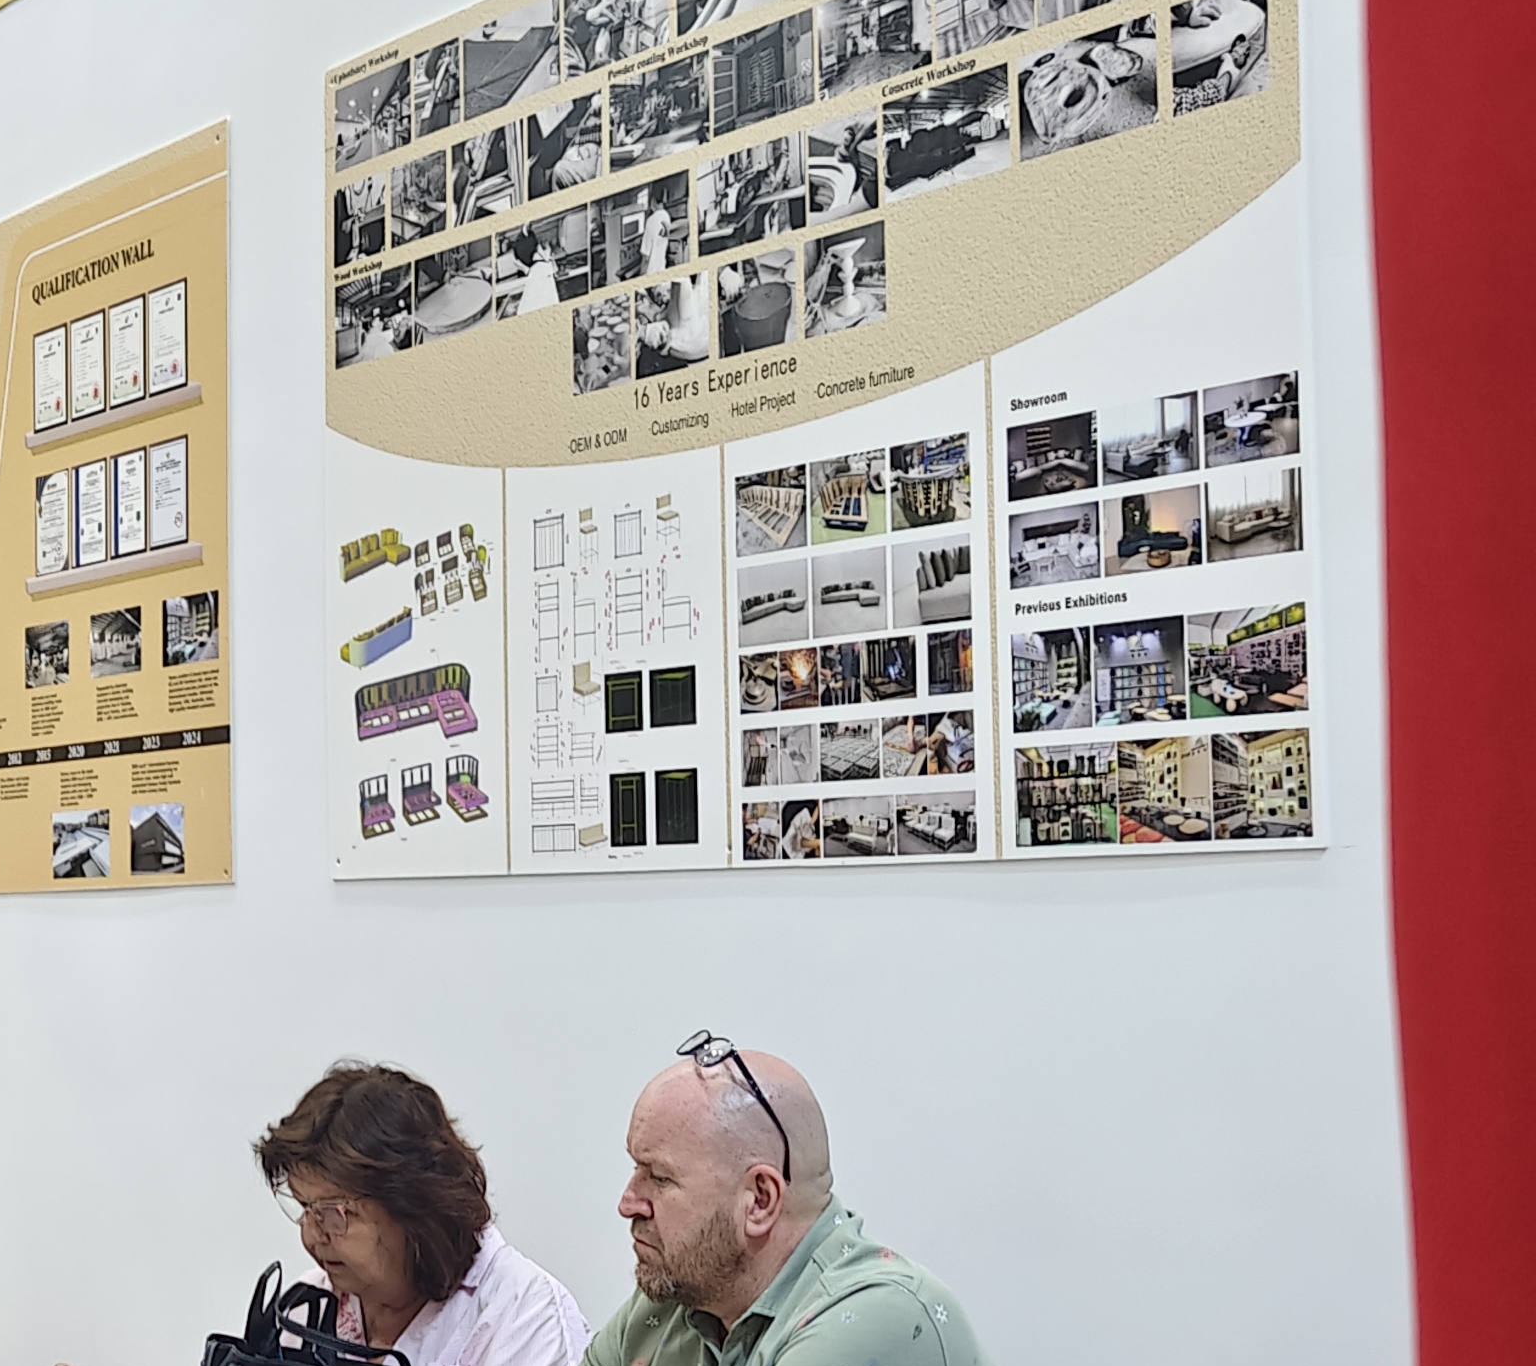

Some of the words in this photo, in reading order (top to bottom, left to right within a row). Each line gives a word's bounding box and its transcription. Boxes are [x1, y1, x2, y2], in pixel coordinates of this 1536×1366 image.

[882, 75, 923, 97] Concrete
[926, 59, 976, 82] Workshop
[32, 251, 120, 305] QUALIFICATION
[121, 239, 155, 268] WALL
[632, 387, 650, 411] 16
[656, 377, 700, 405] Years
[708, 356, 798, 393] Experience
[817, 377, 866, 400] Concrete
[868, 364, 916, 388] furniture
[731, 400, 758, 419] Hotel
[760, 392, 797, 414] Project
[1010, 391, 1068, 412] Showroom
[604, 428, 627, 447] ODM
[651, 412, 710, 436] Customizing
[1015, 600, 1062, 616] Previous
[1065, 592, 1128, 609] Exhibitions
[68, 744, 86, 759] 2020
[104, 740, 121, 755] 2021
[142, 736, 161, 751] 2023
[183, 731, 202, 746] 2024
